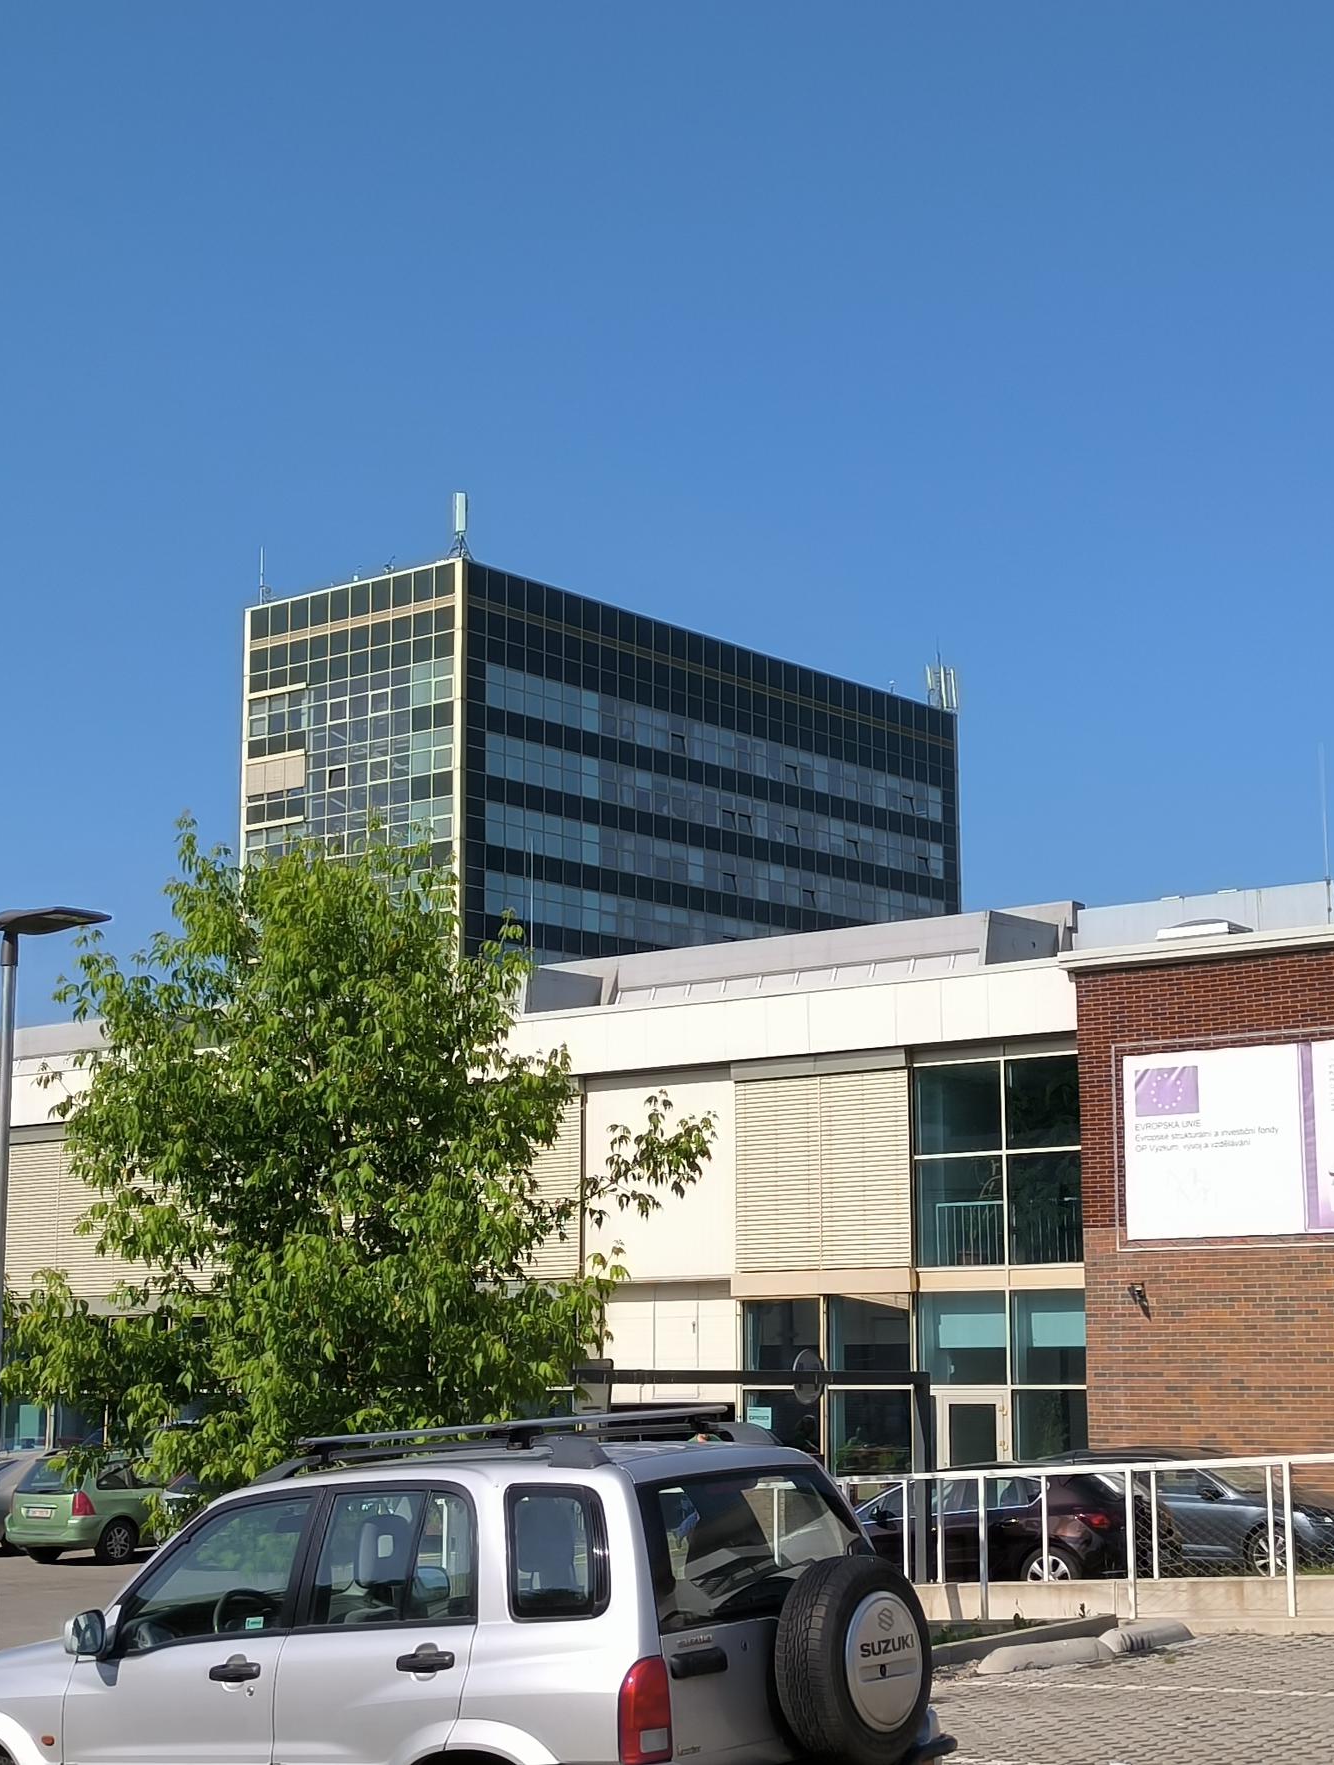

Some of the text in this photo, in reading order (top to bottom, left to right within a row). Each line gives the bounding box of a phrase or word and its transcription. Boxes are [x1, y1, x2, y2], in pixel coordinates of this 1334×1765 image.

[1258, 1125, 1279, 1135] fondy
[1135, 1144, 1148, 1152] OP
[860, 1633, 914, 1658] SUZUKI
